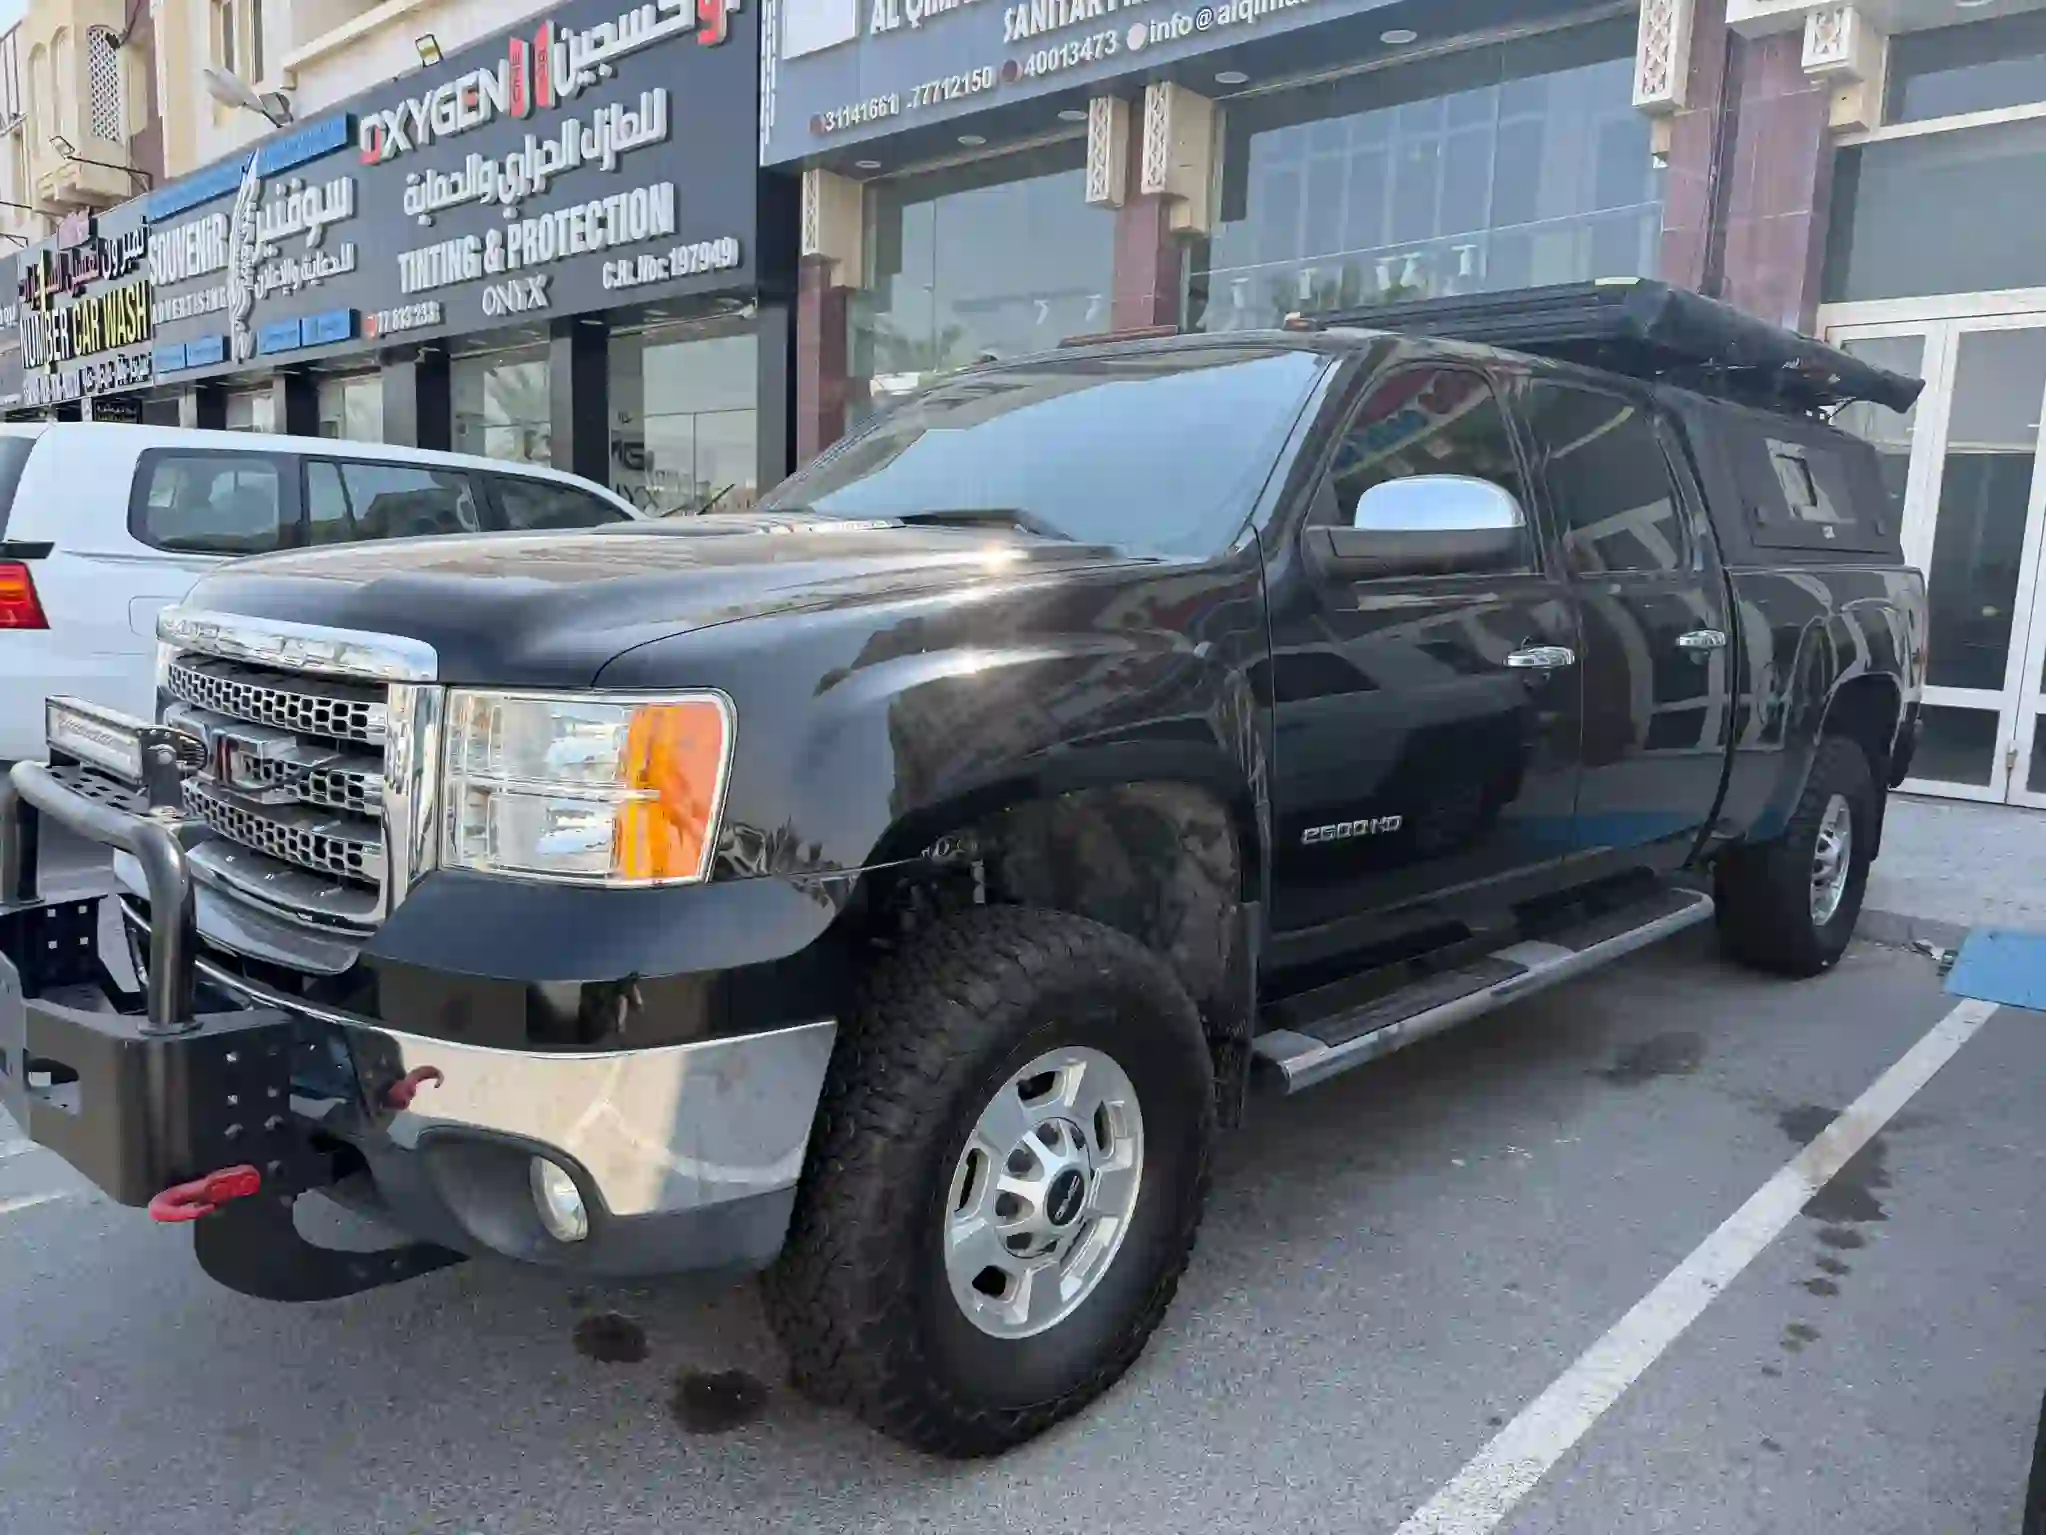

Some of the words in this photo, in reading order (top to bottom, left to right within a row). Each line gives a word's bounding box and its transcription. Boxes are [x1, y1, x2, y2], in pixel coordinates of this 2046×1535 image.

[1002, 0, 1117, 44] SANITA
[1023, 29, 1118, 79] 40013473
[358, 58, 511, 165] OXYGEN
[397, 235, 482, 294] TINTING
[483, 228, 506, 275] &
[507, 181, 676, 270] PROTECTION
[72, 297, 101, 356] CAR
[102, 280, 148, 349] WASH
[482, 274, 549, 317] ONYX
